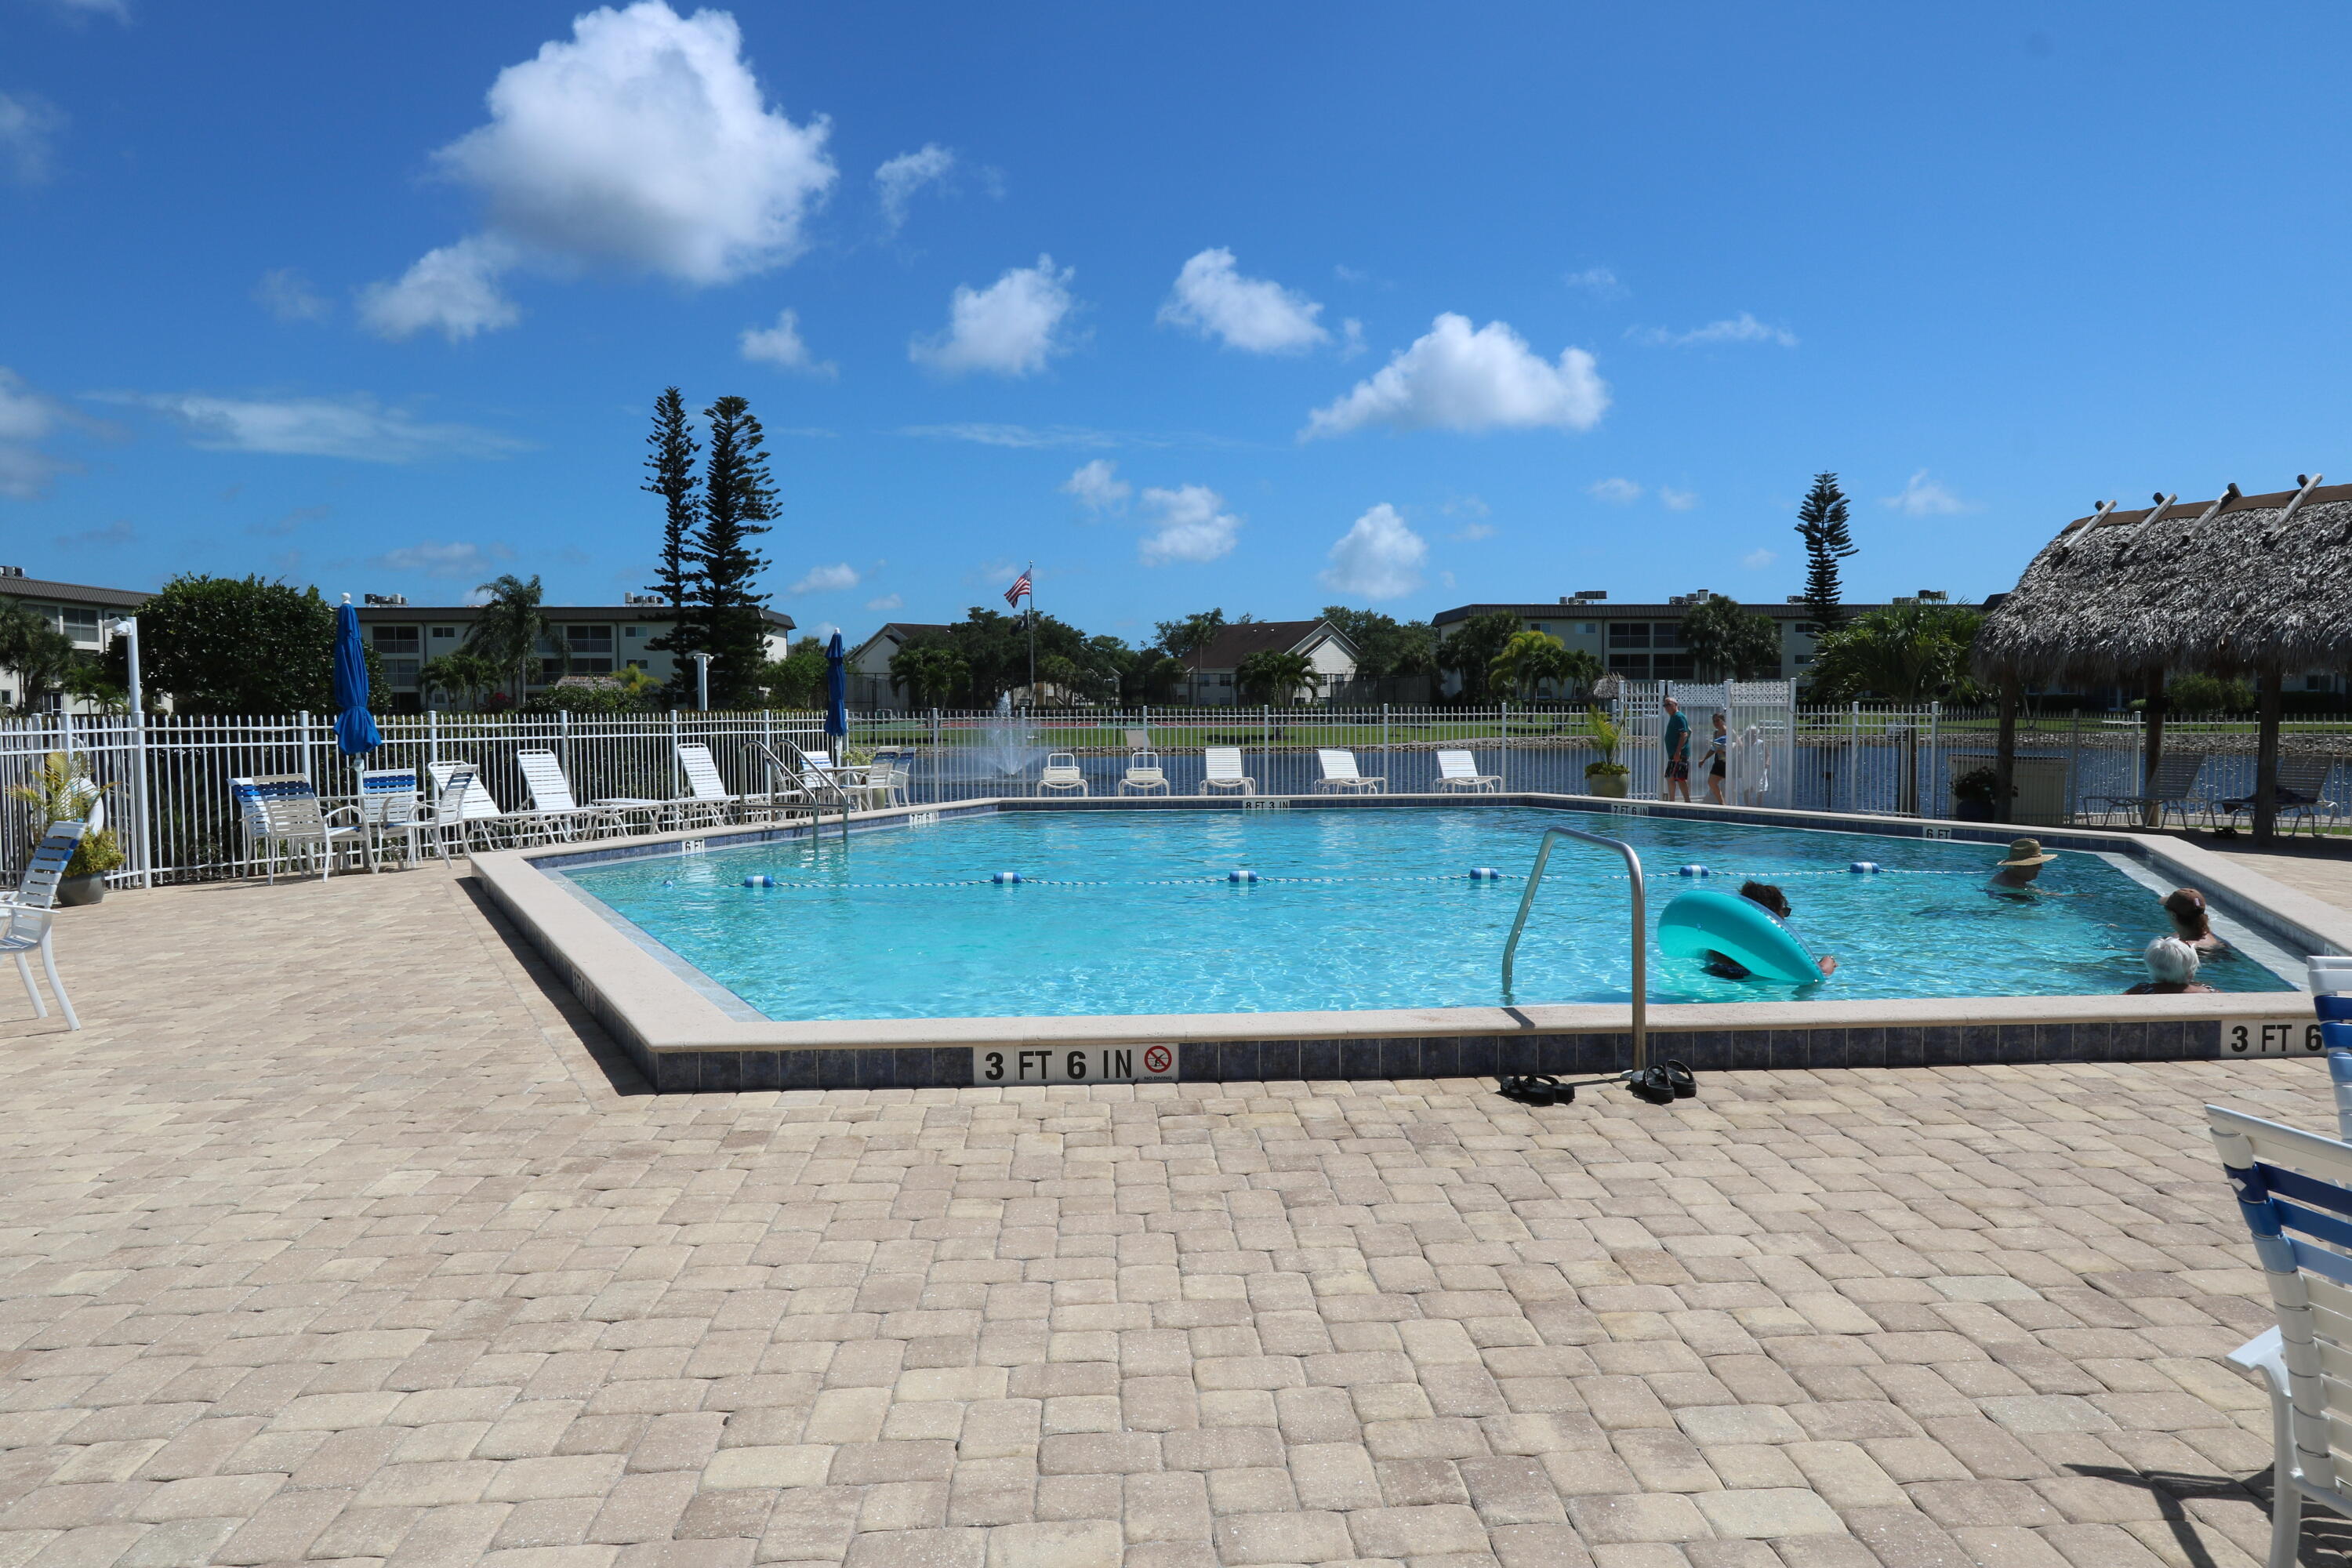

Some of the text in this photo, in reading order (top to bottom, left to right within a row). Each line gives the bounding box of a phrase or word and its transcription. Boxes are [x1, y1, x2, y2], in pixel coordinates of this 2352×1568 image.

[1279, 800, 1288, 809] IN
[1613, 805, 1618, 814] 7
[1621, 806, 1629, 815] FT
[1926, 828, 1950, 839] 6 FT
[685, 840, 702, 851] 6 FT
[2231, 1024, 2322, 1052] 3 FT 6
[985, 1049, 1132, 1081] 3 FT 6 IN
